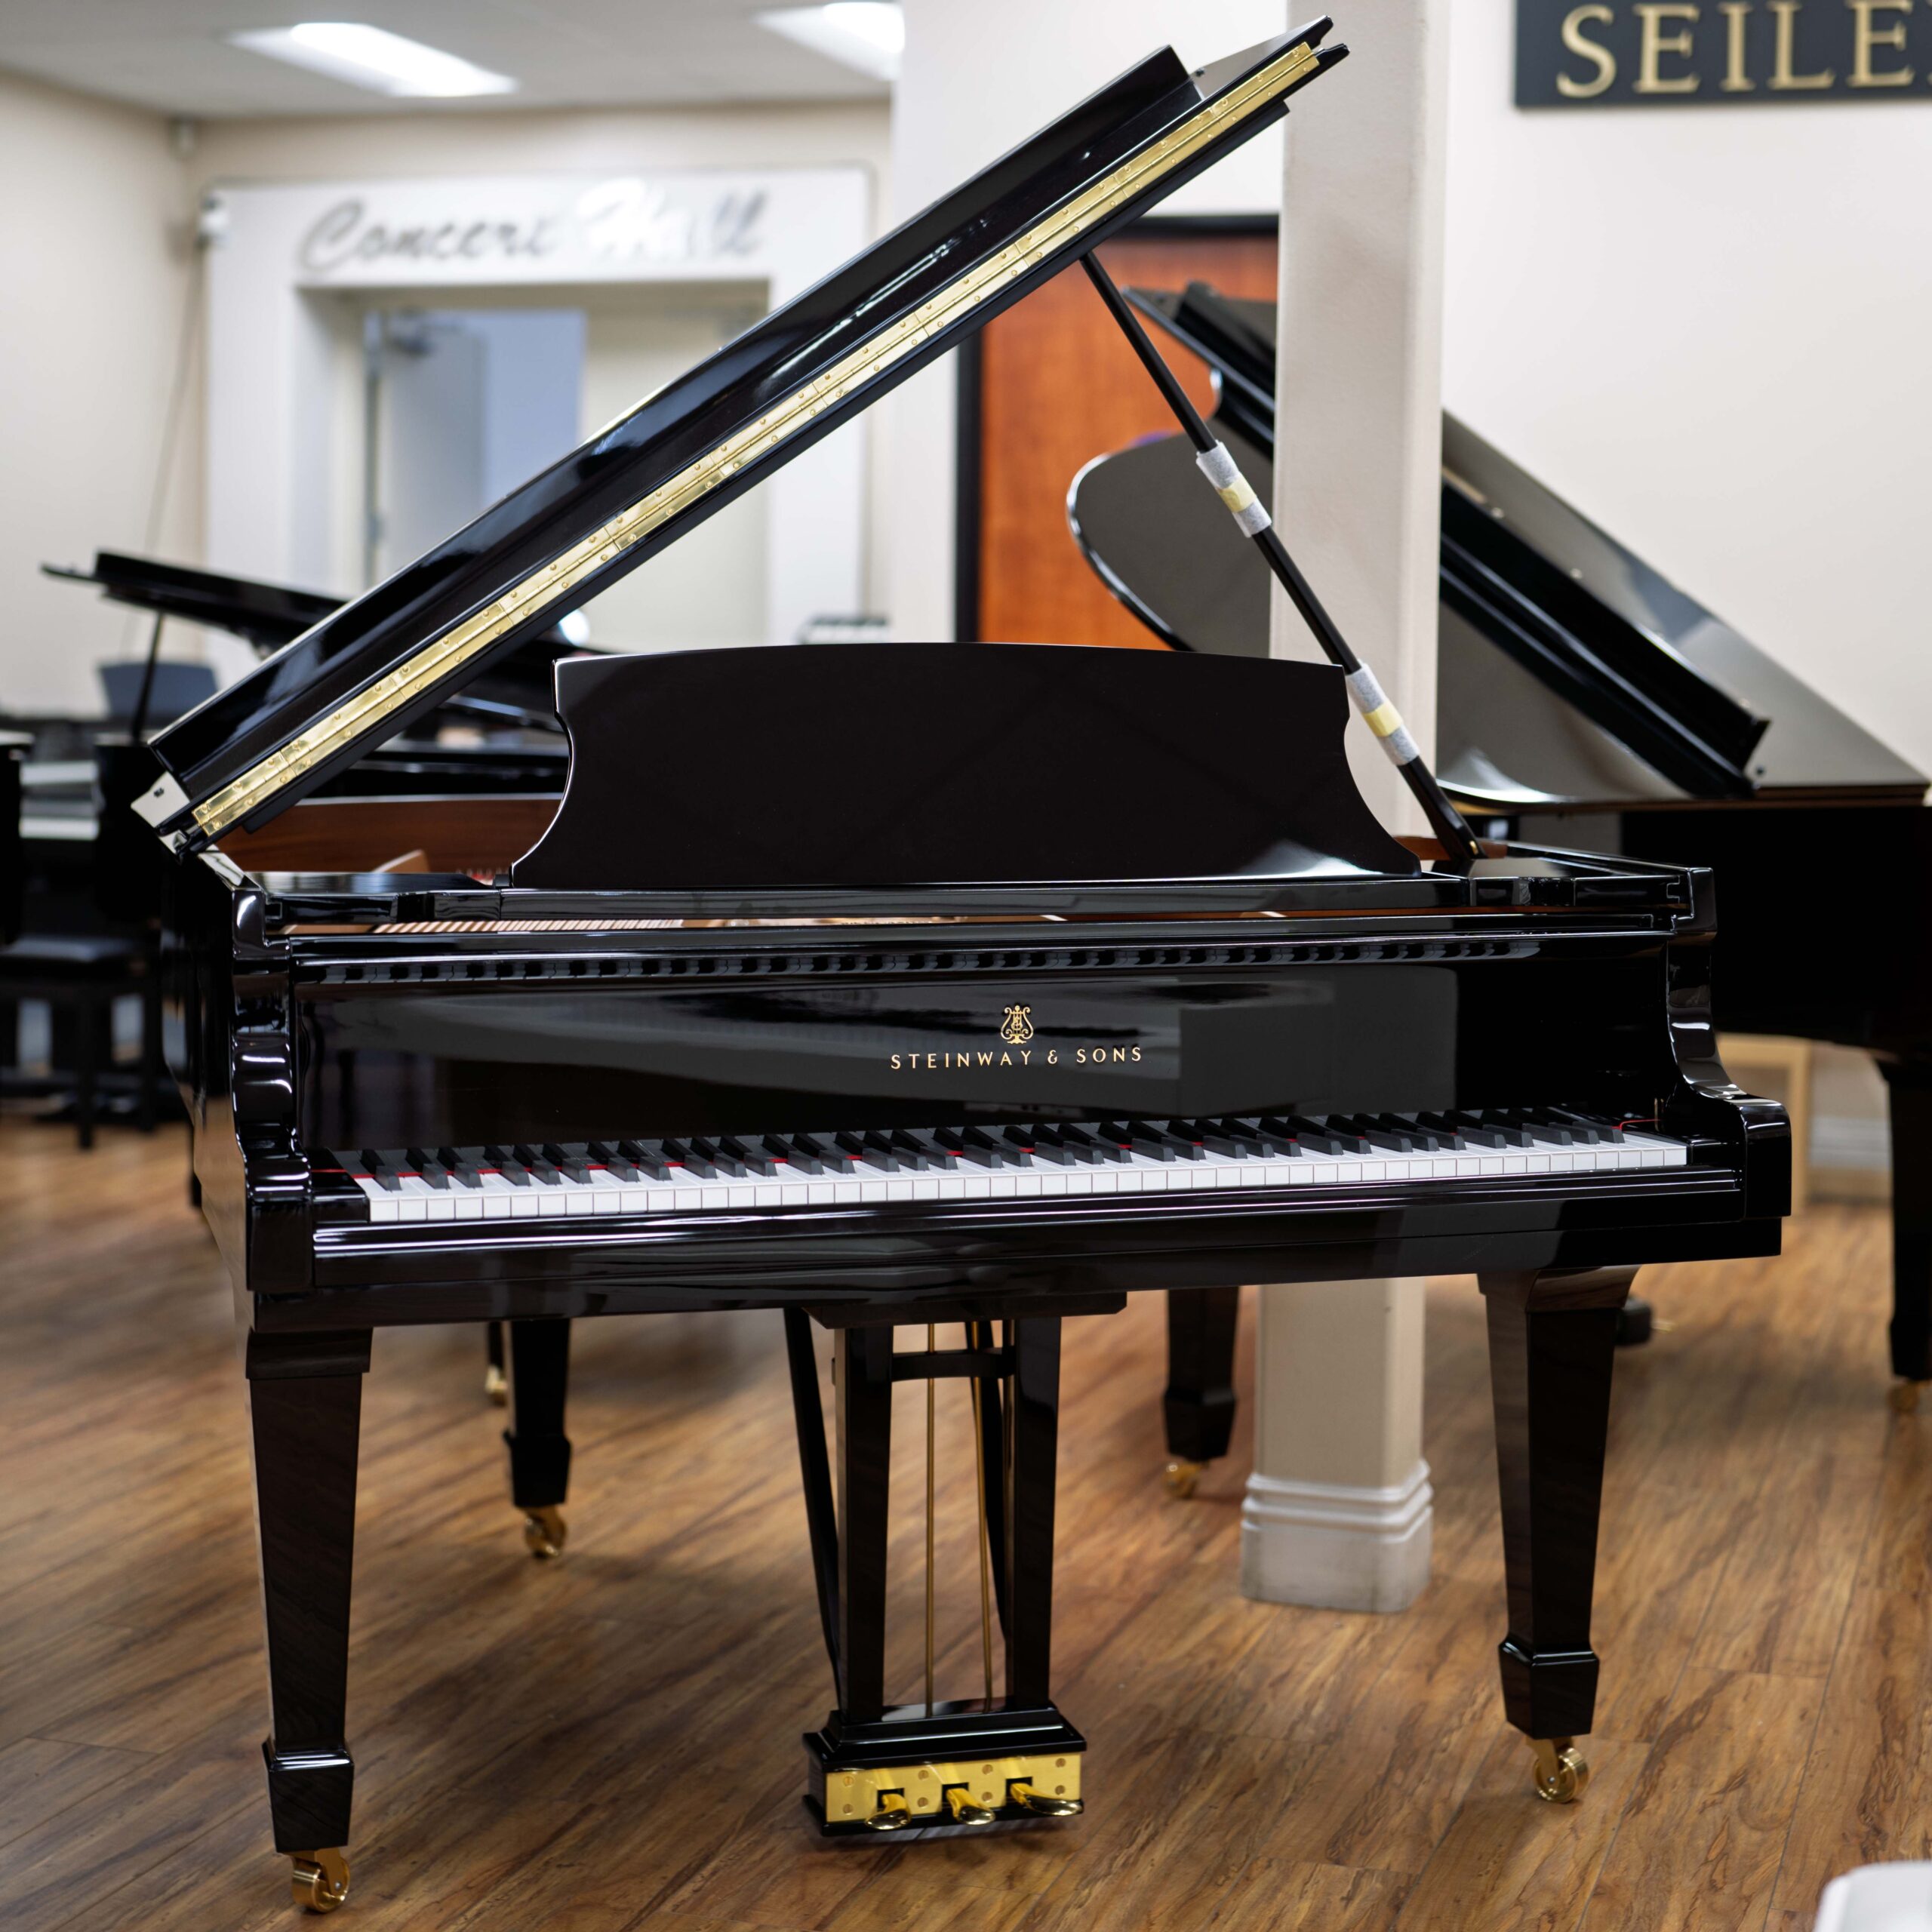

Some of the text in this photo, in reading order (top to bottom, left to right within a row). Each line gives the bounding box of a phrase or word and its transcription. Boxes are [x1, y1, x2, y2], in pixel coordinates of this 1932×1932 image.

[1555, 0, 1932, 97] SEILE
[298, 195, 562, 272] Concert
[891, 1047, 1141, 1069] STEINWAY & SONS
